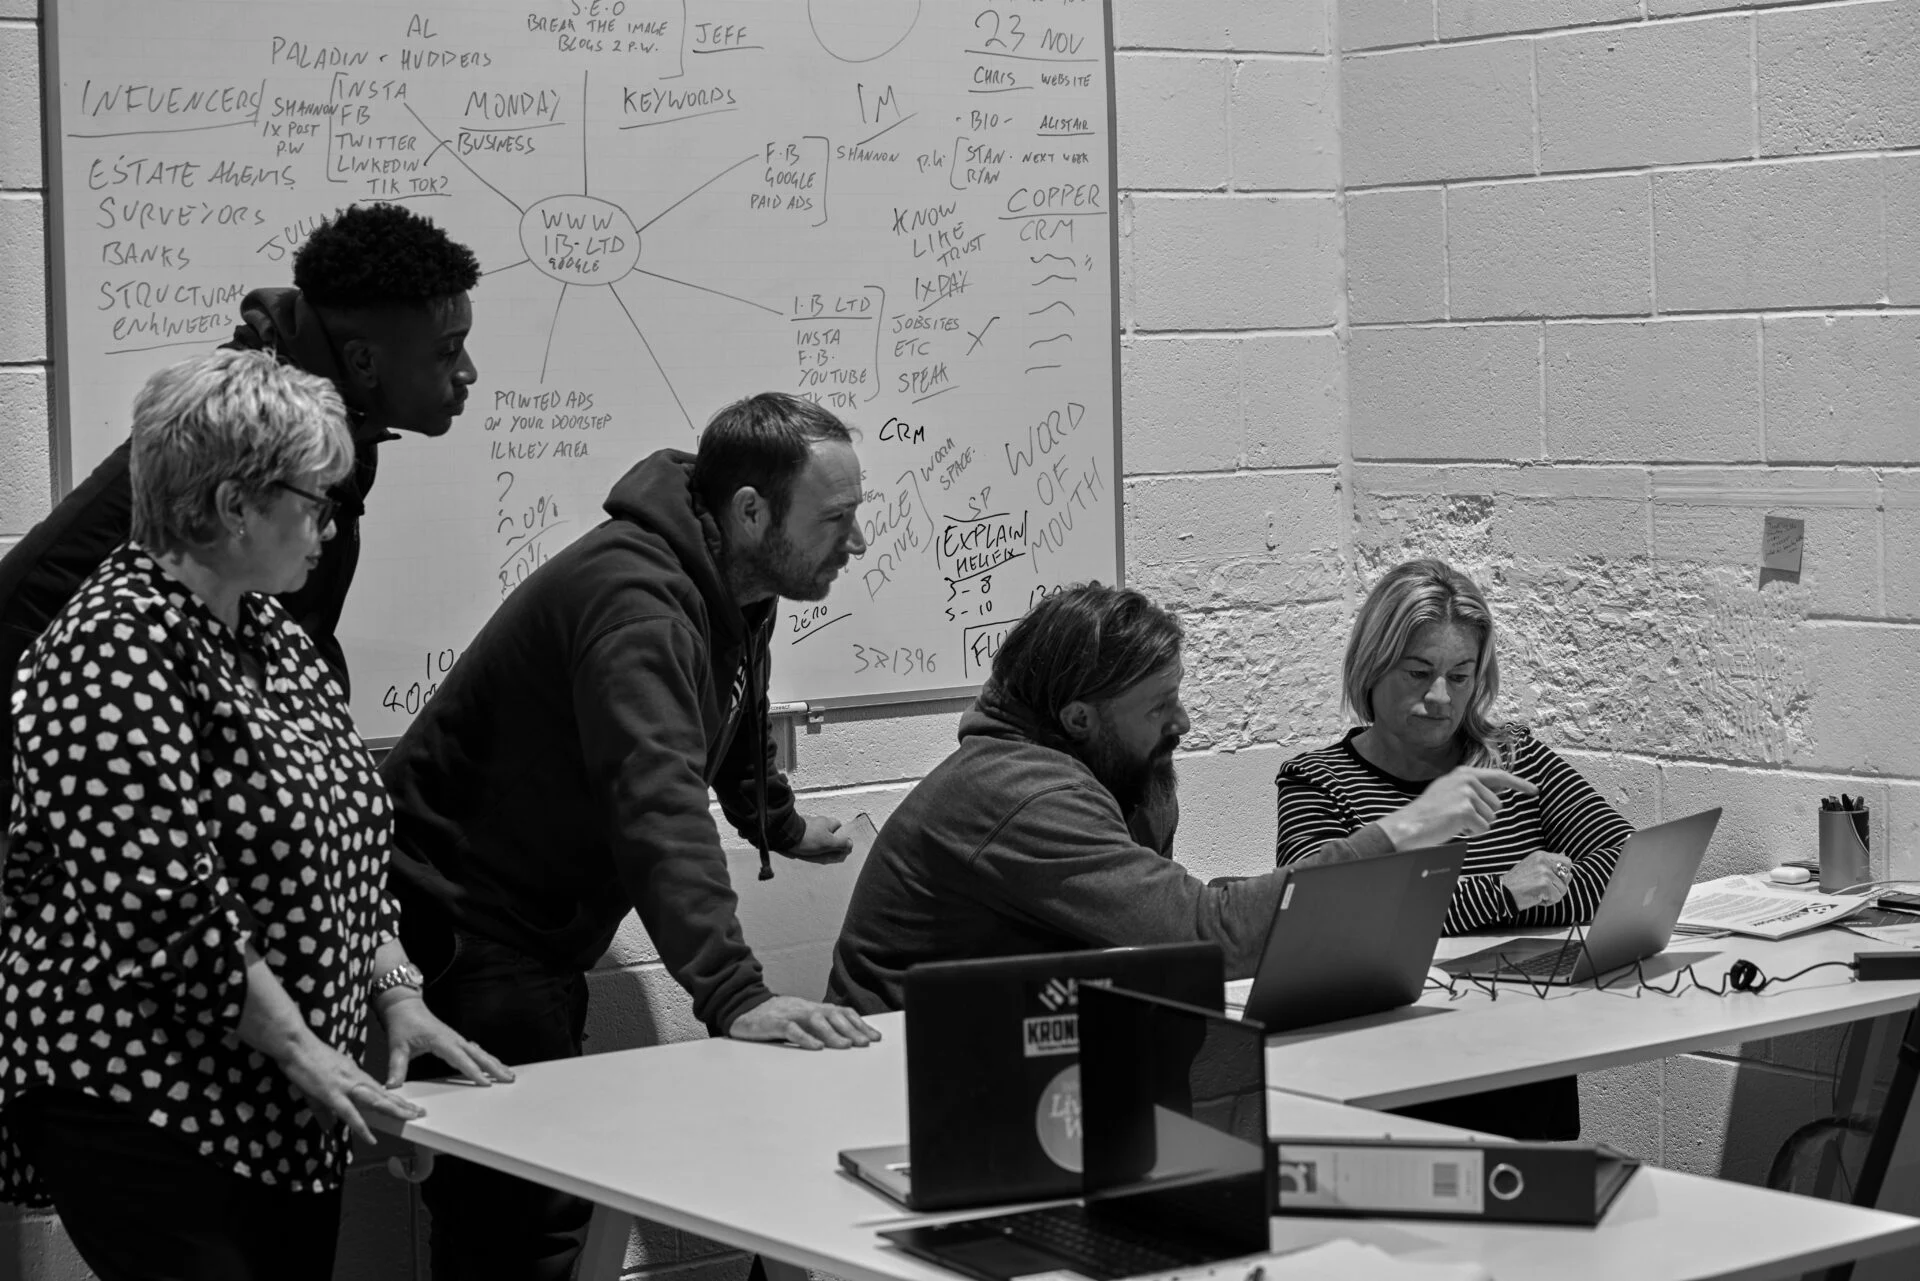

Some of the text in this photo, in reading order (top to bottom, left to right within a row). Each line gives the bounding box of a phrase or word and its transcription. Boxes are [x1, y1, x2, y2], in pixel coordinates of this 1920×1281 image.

[407, 14, 437, 38] AL
[527, 14, 575, 32] BREAK
[586, 18, 616, 32] THE
[974, 10, 1084, 54] 23 NOV
[558, 34, 603, 52] BLOGS
[612, 40, 621, 52] 2
[695, 23, 748, 45] JEFF
[272, 36, 492, 70] PALADIN HUDDERS
[974, 66, 1091, 87] CHRIS WEBSITE
[339, 79, 407, 99] INSTA
[271, 97, 338, 117] SHANNON
[465, 89, 560, 121] MONDAY
[623, 87, 736, 113] KEYWORDS
[340, 104, 370, 125] FB
[1040, 115, 1088, 130] ALISTAIR
[288, 124, 320, 137] POST
[335, 133, 417, 151] TWITTER
[458, 132, 535, 155] BUSINESS
[337, 156, 419, 173] LINKEDIN
[837, 146, 900, 162] SHANNON
[966, 144, 1088, 164] STAN NEXT WEEK
[88, 155, 200, 190] ESTATE
[765, 167, 816, 189] GOOGLE
[967, 166, 1000, 184] RYAN
[367, 178, 400, 194] TIK
[750, 194, 813, 210] PAID ADS
[1007, 184, 1100, 212] COPPER
[97, 197, 265, 229] SURVEYORS
[893, 202, 956, 236] KNOW
[914, 222, 964, 258] LIKE
[1020, 218, 1073, 243] CRM
[102, 241, 190, 270] BANKS
[937, 233, 986, 267] TRUST
[98, 281, 247, 310] STRUCTURAL
[835, 297, 871, 312] LTD
[892, 314, 960, 334] JOBSITES
[797, 329, 841, 345] INSTA
[894, 338, 930, 358] ETC
[799, 368, 866, 387] YOUTUBE
[898, 362, 949, 393] SPEAK
[566, 390, 594, 411] ADS
[828, 391, 857, 409] TOK
[484, 413, 612, 432] ON YOUR DOORSTEP
[879, 417, 925, 445] CRM
[1005, 402, 1085, 475] WORD
[491, 440, 590, 459] ILKLEY AREA
[1037, 454, 1069, 505] OF
[1031, 456, 1104, 574] MOUTH
[944, 523, 1024, 557] EXPLAIN
[863, 516, 919, 600] DRIVE
